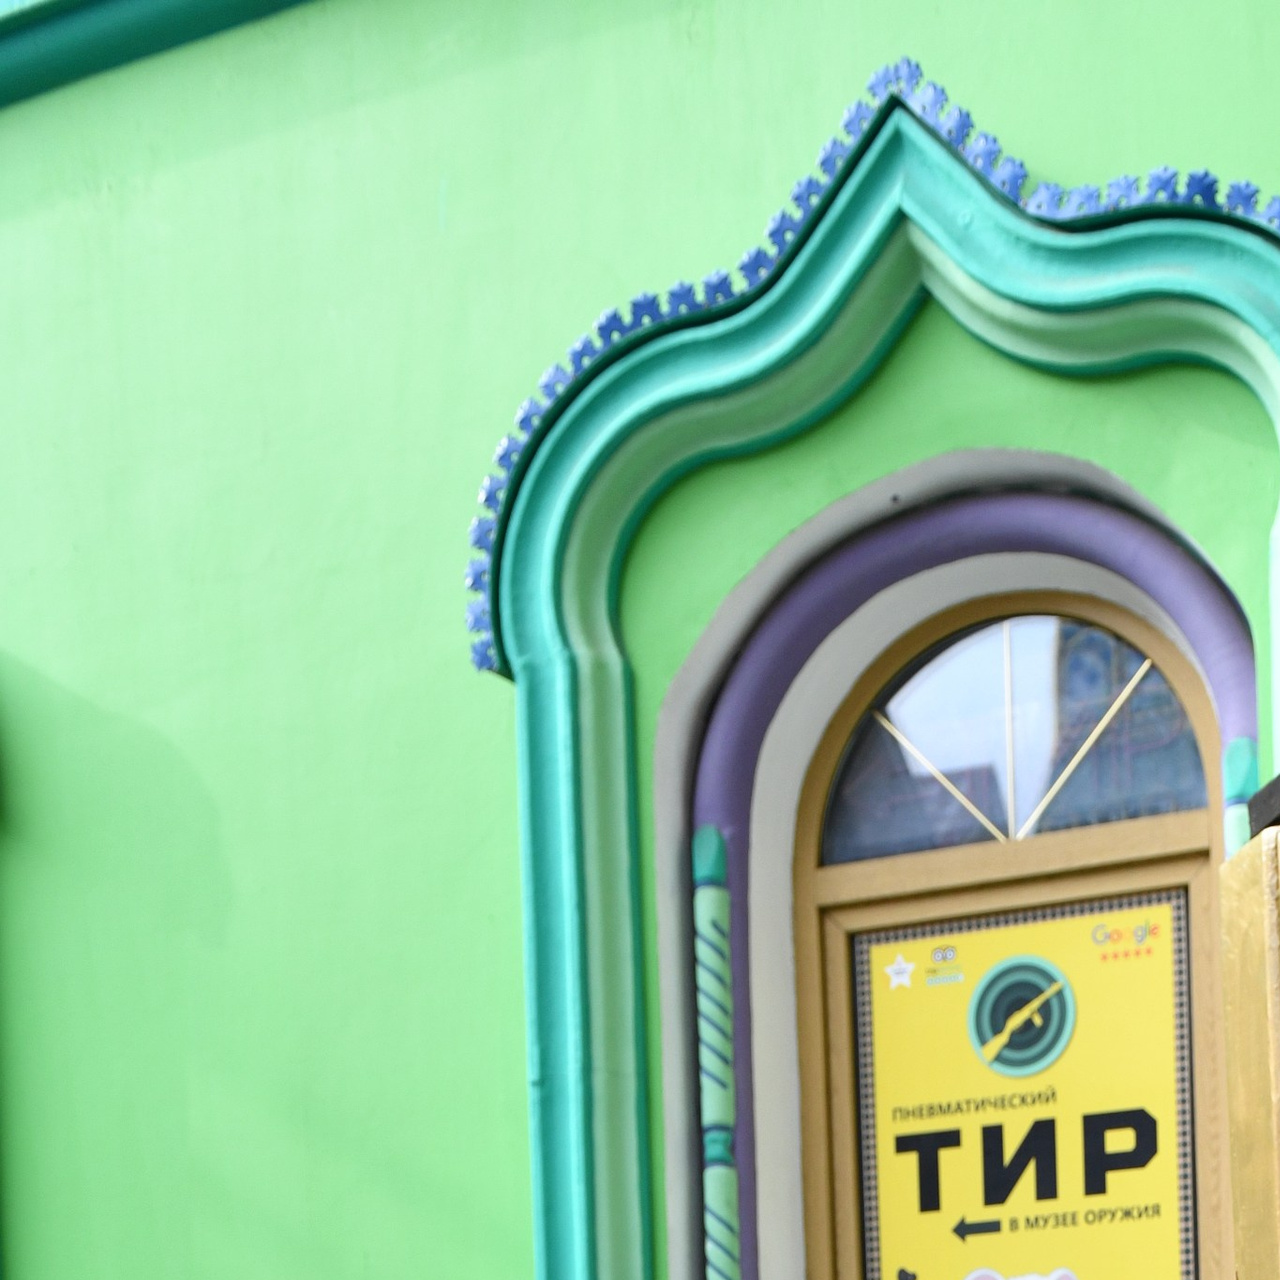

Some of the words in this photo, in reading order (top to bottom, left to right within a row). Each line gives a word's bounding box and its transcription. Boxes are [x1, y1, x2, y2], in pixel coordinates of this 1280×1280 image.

[1092, 918, 1161, 946] Google
[892, 1086, 1057, 1122] ПНЕВМАТИЧЕСКИЙ
[895, 1109, 1158, 1213] ТИР
[1009, 1213, 1020, 1232] В
[1024, 1209, 1079, 1231] МУЗЕЕ
[1084, 1203, 1162, 1226] ОРУЖИЯ
